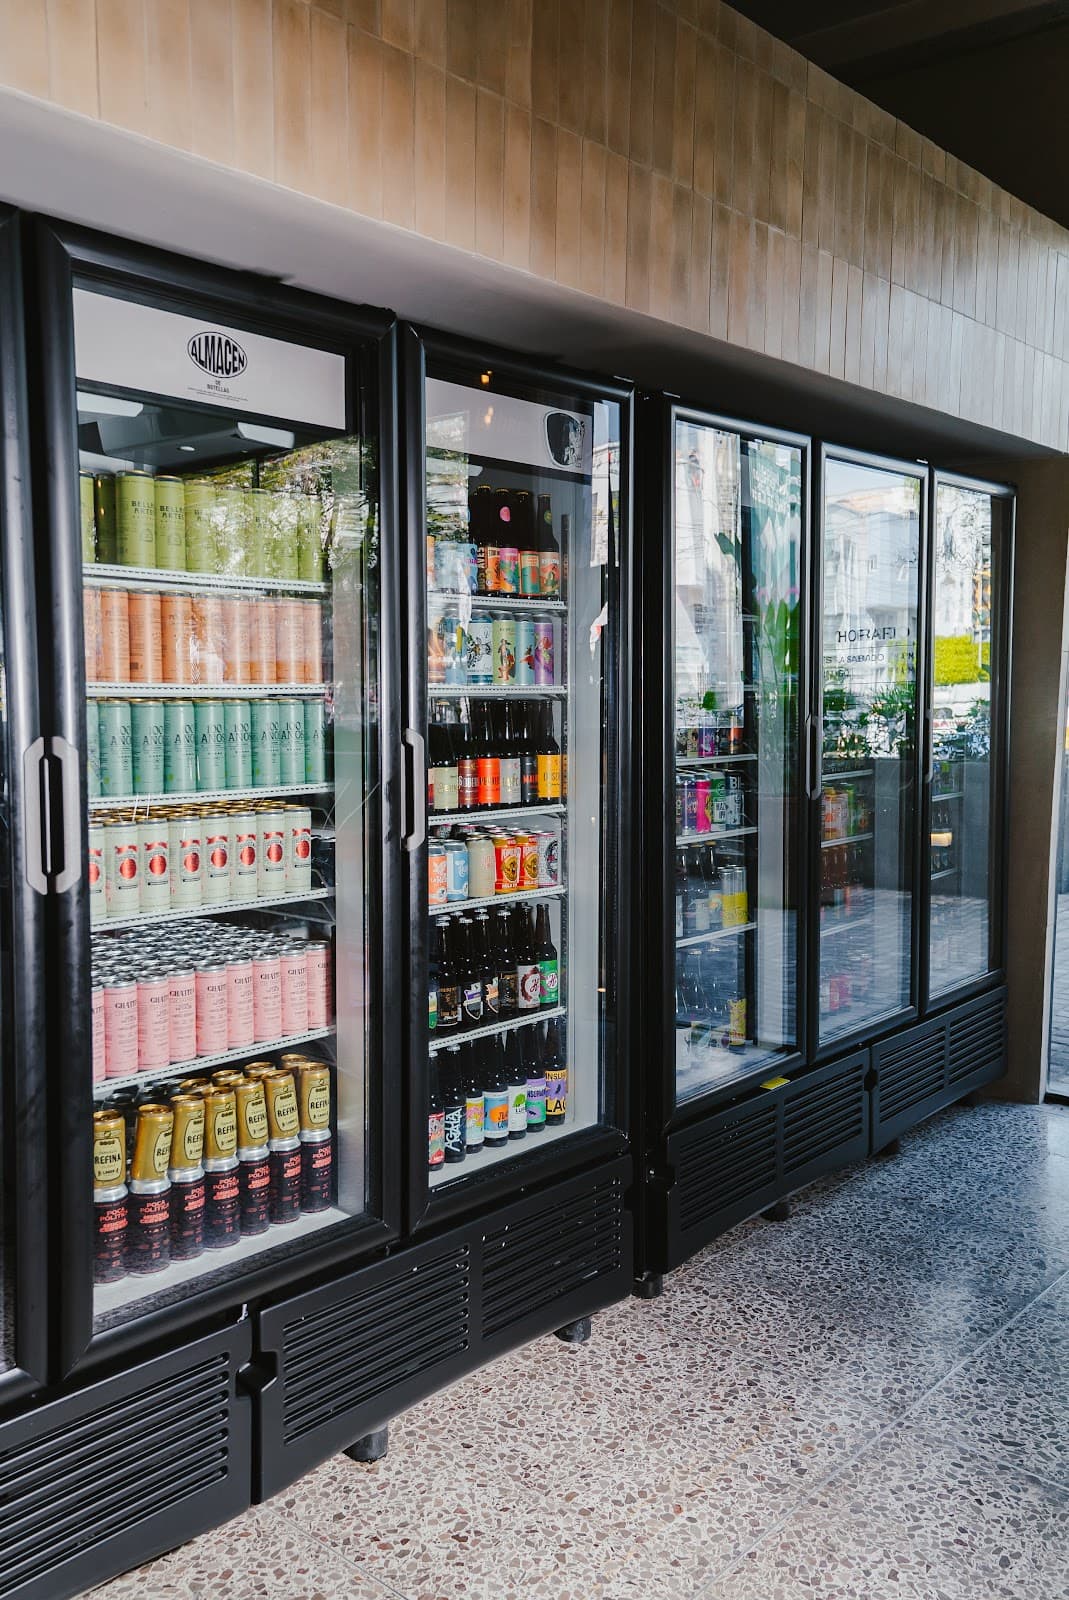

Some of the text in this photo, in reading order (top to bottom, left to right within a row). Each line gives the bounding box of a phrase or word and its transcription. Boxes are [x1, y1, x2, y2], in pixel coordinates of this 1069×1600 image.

[190, 335, 245, 376] ALMACEN
[310, 1100, 328, 1109] REFIN
[248, 1114, 266, 1124] REFIN
[217, 1125, 234, 1136] REFIN
[94, 1154, 121, 1164] REFINA
